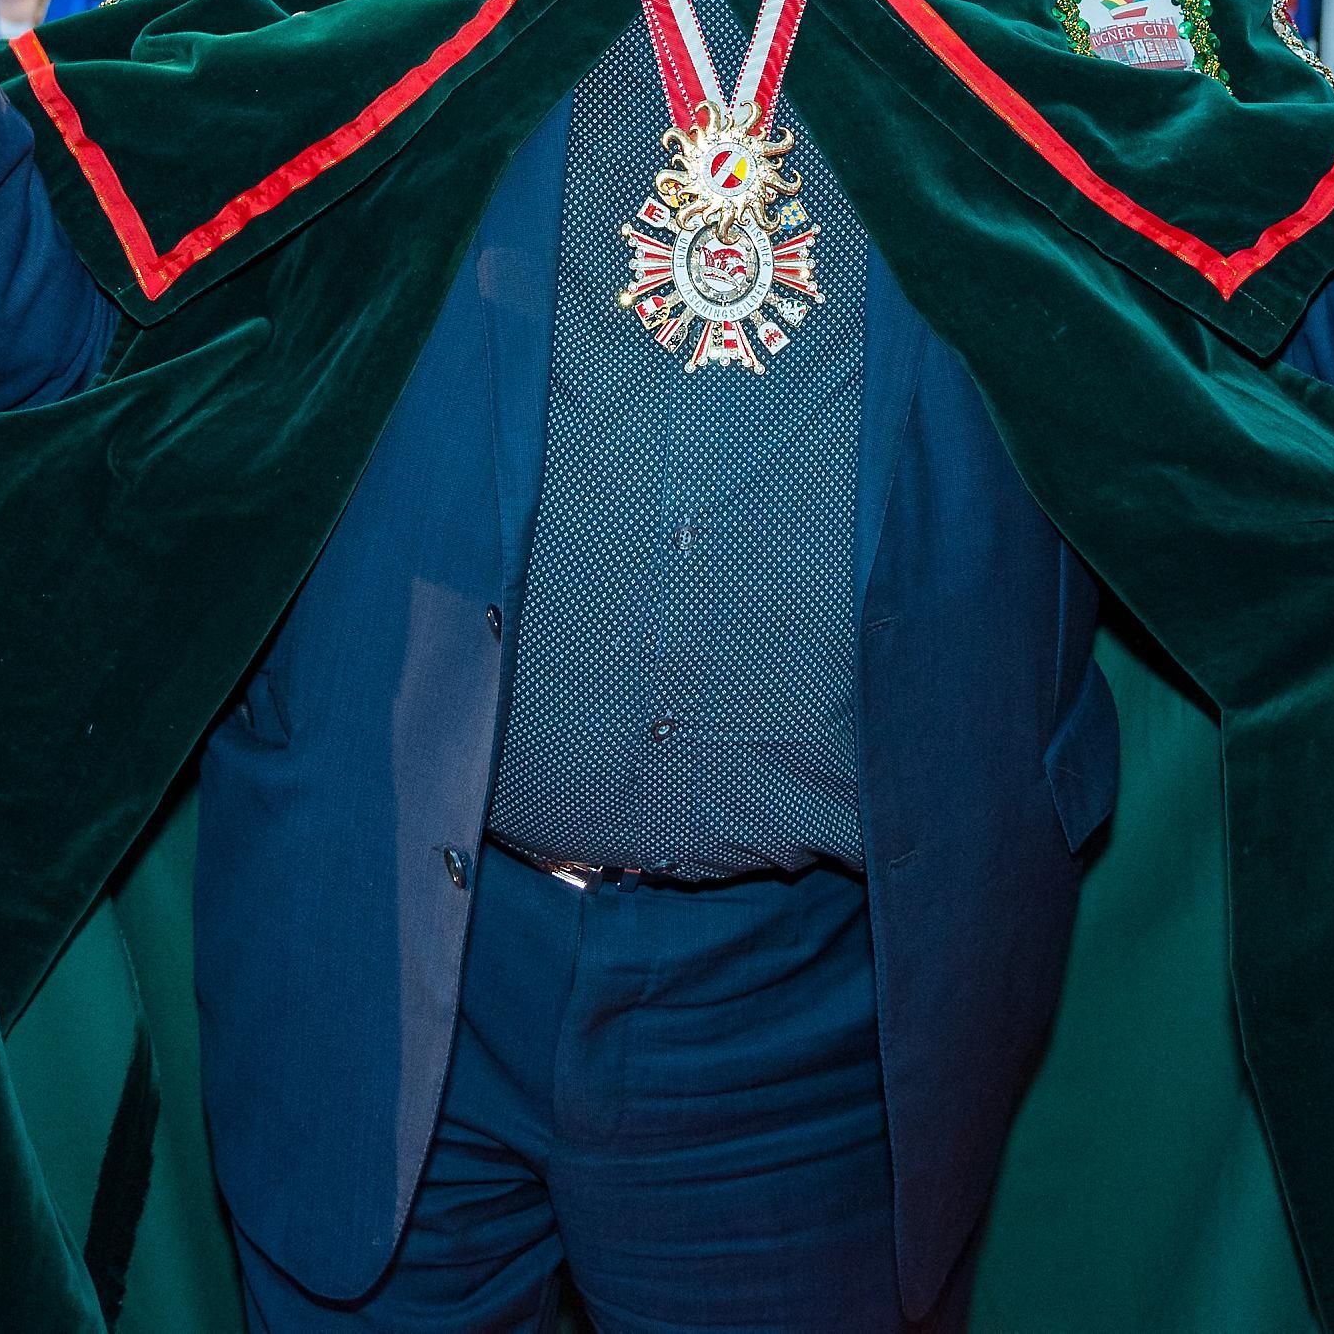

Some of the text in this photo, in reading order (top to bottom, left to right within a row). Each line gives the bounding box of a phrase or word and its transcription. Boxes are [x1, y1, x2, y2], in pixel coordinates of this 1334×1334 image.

[1144, 24, 1168, 37] CITY
[676, 238, 689, 268] BUND
[681, 283, 767, 320] FASCHINGSGILDEN
